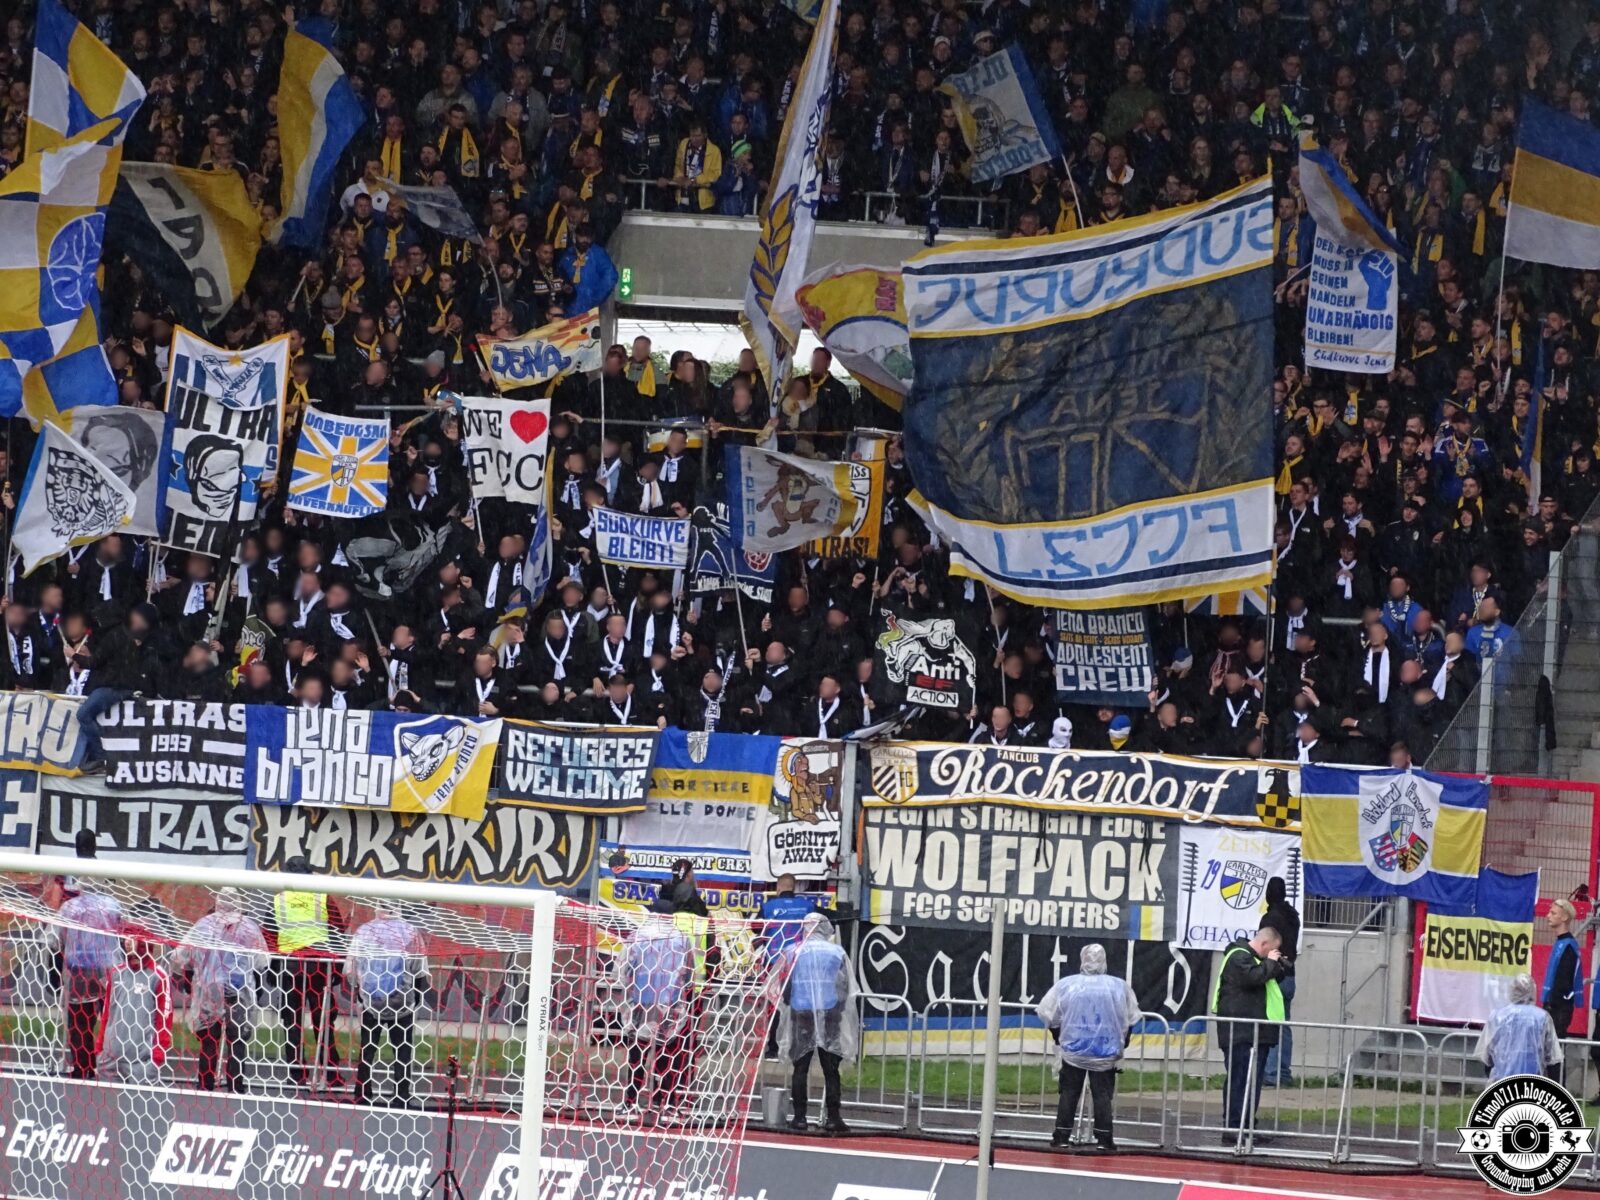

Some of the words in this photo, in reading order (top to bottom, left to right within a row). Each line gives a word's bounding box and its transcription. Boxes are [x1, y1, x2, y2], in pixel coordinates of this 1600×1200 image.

[1314, 254, 1340, 271] MUSS
[1312, 270, 1348, 289] SEINEM
[1310, 288, 1356, 308] HANDELN
[1308, 306, 1394, 331] UNABHÄNGIG
[1307, 327, 1354, 346] BLEIBEN!
[490, 341, 571, 379] JENA
[463, 409, 503, 440] WE
[470, 447, 545, 492] FCC
[597, 512, 686, 544] SÜDKURVE
[608, 537, 674, 562] BLEIBT!
[910, 655, 960, 680] Anti
[1056, 642, 1148, 666] ADOLESCENT
[1056, 664, 1152, 692] CREW
[910, 689, 957, 705] ACTION
[151, 734, 193, 752] 1993
[507, 728, 654, 768] REFUGEES
[997, 748, 1040, 764] FANCLUB
[106, 760, 244, 789] AUSANNE
[504, 760, 647, 800] WELCOME
[929, 746, 1247, 825] Rockendorf
[50, 795, 250, 852] ULTRAS
[960, 806, 1093, 837] STRAIGHT
[264, 806, 585, 881] HARAKIRI
[782, 847, 825, 865] AWAY
[866, 826, 1167, 903] WOLFPACK
[903, 891, 952, 919] FCC
[960, 896, 1121, 931] SUPPORTERS
[1426, 925, 1530, 966] EISENBERG
[539, 996, 548, 1031] CYRIAX
[6, 1119, 110, 1166] Erfurt.
[170, 1134, 244, 1177] SWE
[263, 1142, 323, 1182] Für
